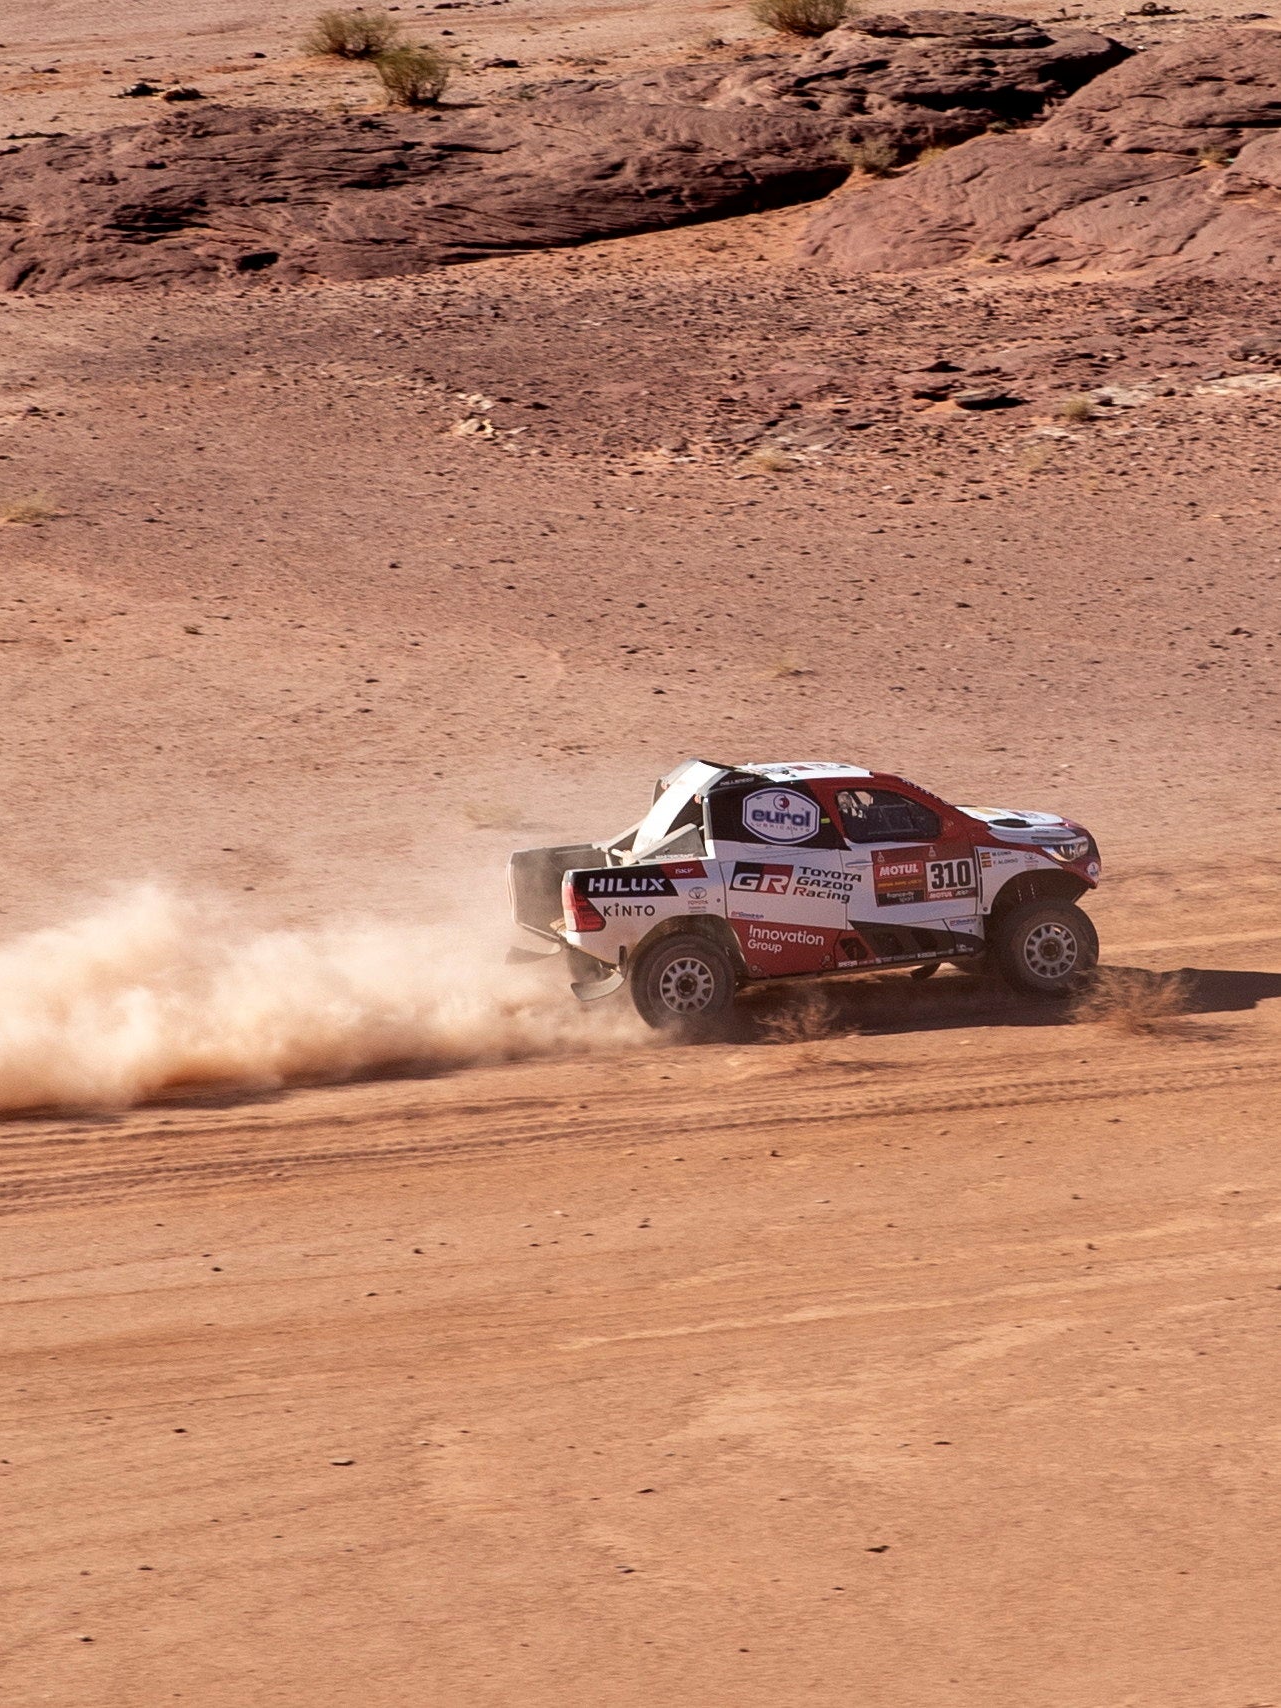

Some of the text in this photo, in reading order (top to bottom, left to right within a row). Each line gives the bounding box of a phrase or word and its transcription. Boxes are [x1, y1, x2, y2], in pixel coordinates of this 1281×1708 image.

[751, 809, 811, 827] eurol
[798, 866, 862, 882] TOYOTA
[879, 863, 919, 876] MOTUL
[930, 860, 972, 890] 310
[588, 878, 666, 892] HILUX
[732, 873, 789, 894] GR
[796, 876, 854, 892] GAZOO
[792, 886, 851, 904] Racing
[929, 891, 953, 899] MOTUL
[747, 939, 783, 954] Group
